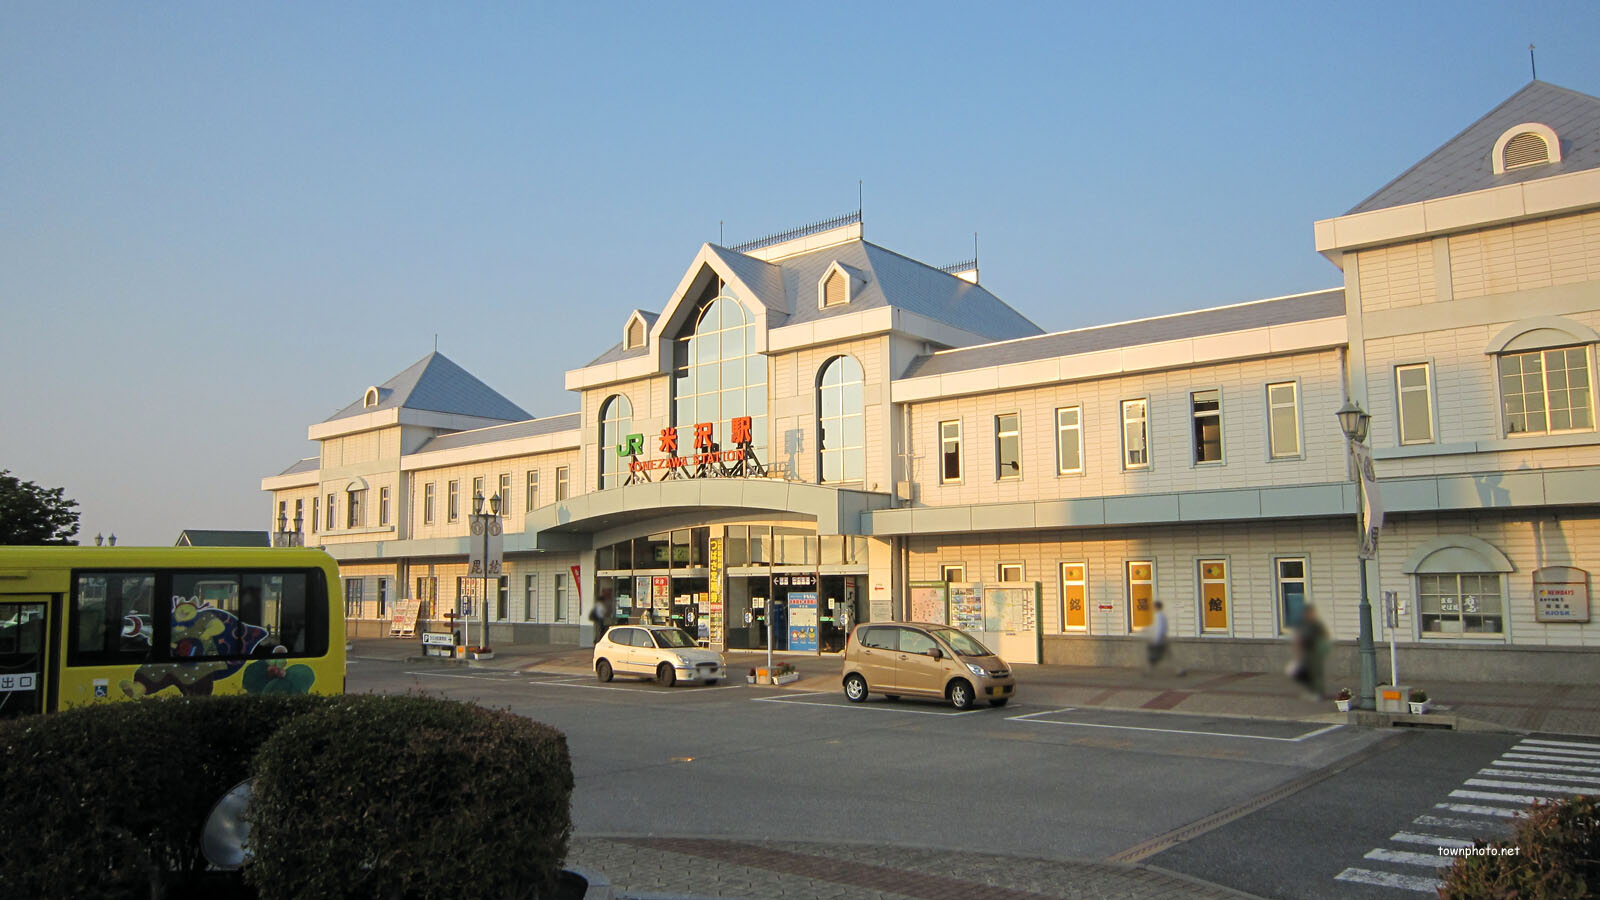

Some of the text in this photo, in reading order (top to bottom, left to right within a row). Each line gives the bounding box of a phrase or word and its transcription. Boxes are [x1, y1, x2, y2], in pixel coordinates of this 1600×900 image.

[616, 416, 752, 457] JR 米沢駅
[628, 449, 745, 473] YONEZAWA STATION
[1, 676, 32, 688] 出口
